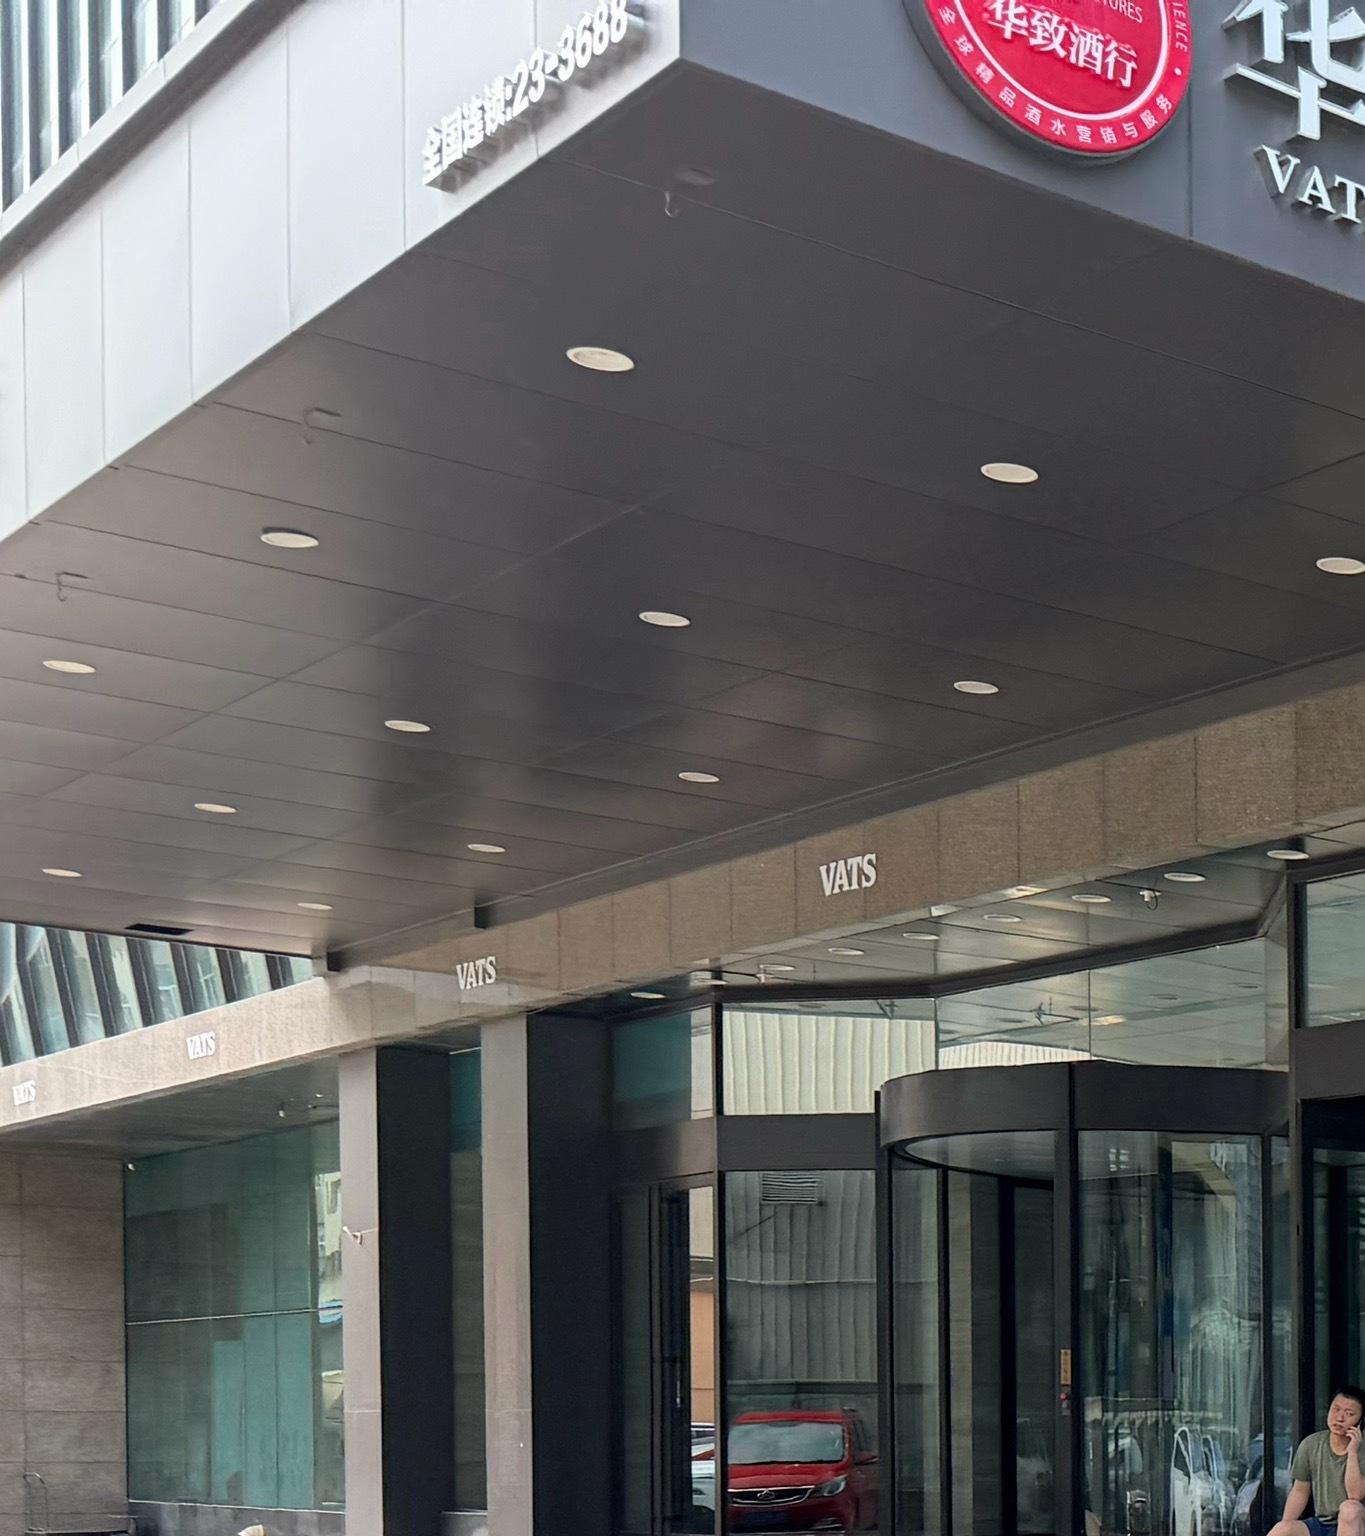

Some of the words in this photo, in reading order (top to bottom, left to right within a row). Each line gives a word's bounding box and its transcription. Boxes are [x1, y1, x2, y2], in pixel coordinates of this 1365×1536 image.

[985, 0, 1138, 88] 华致酒行
[819, 853, 878, 897] VATS
[455, 955, 497, 990] VATS
[185, 1031, 216, 1060] VATS
